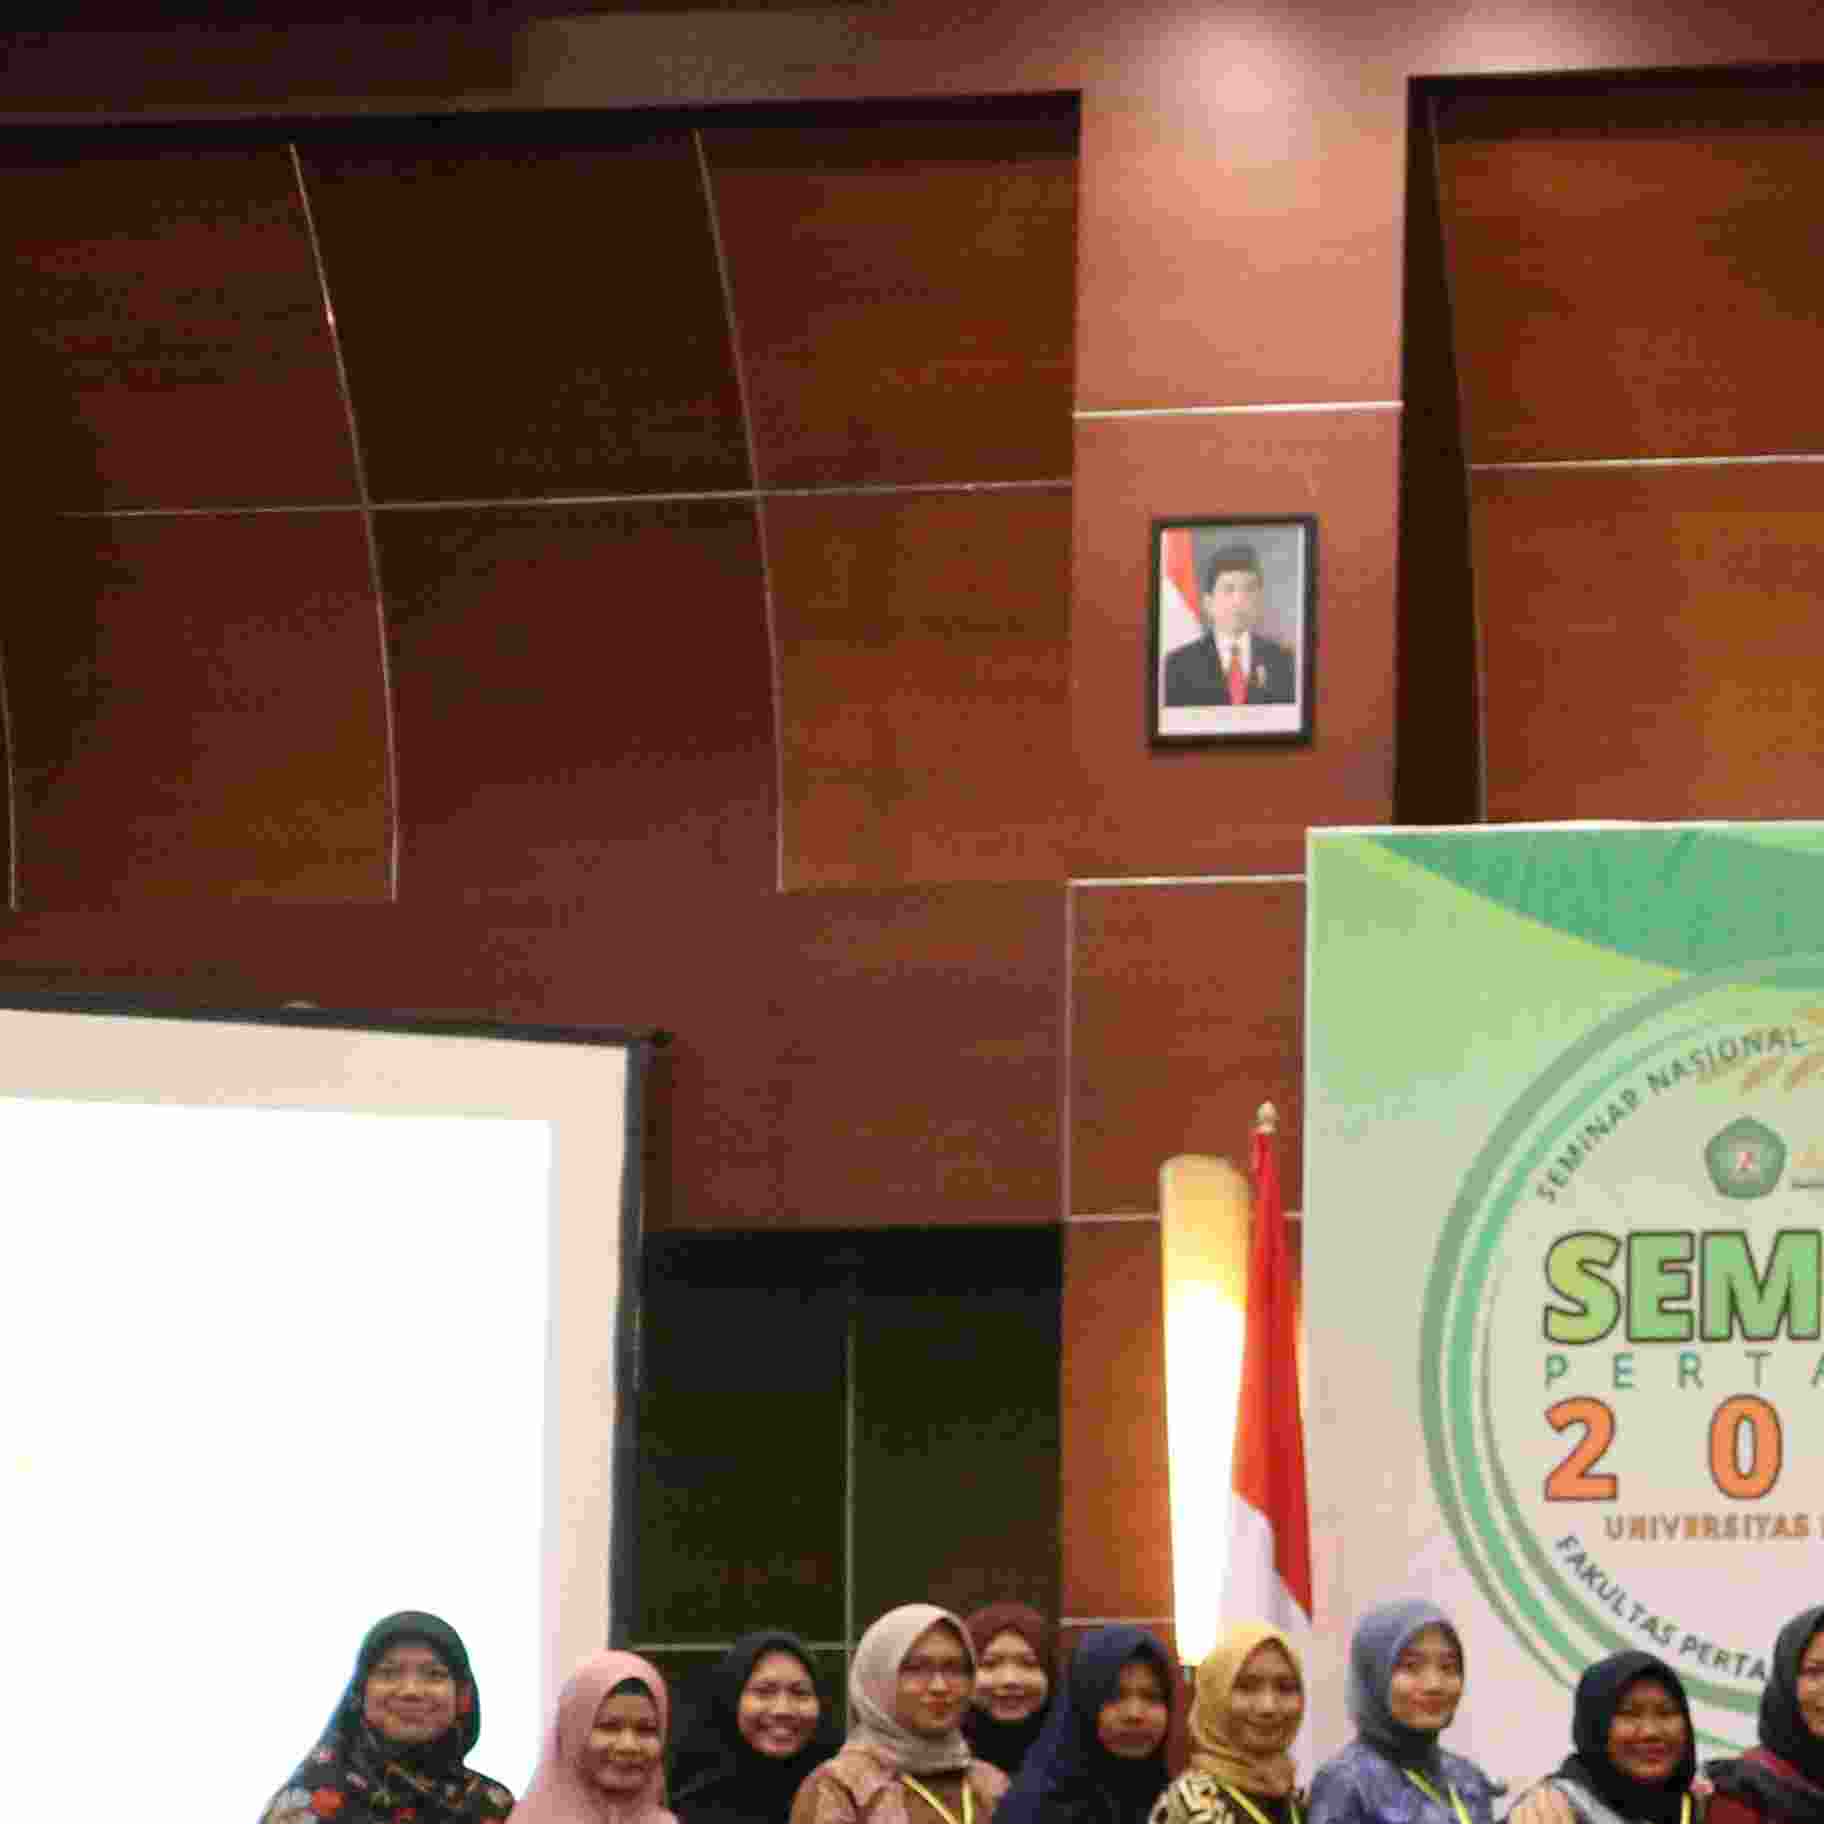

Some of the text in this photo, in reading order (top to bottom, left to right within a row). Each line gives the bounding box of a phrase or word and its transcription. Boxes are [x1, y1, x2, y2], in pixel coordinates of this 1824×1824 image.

[1536, 1026, 1809, 1205] SEMINAR NASIONAL
[1604, 1512, 1810, 1540] UNIVERSITAS
[1554, 1535, 1769, 1682] FAKULTAS PERTA
